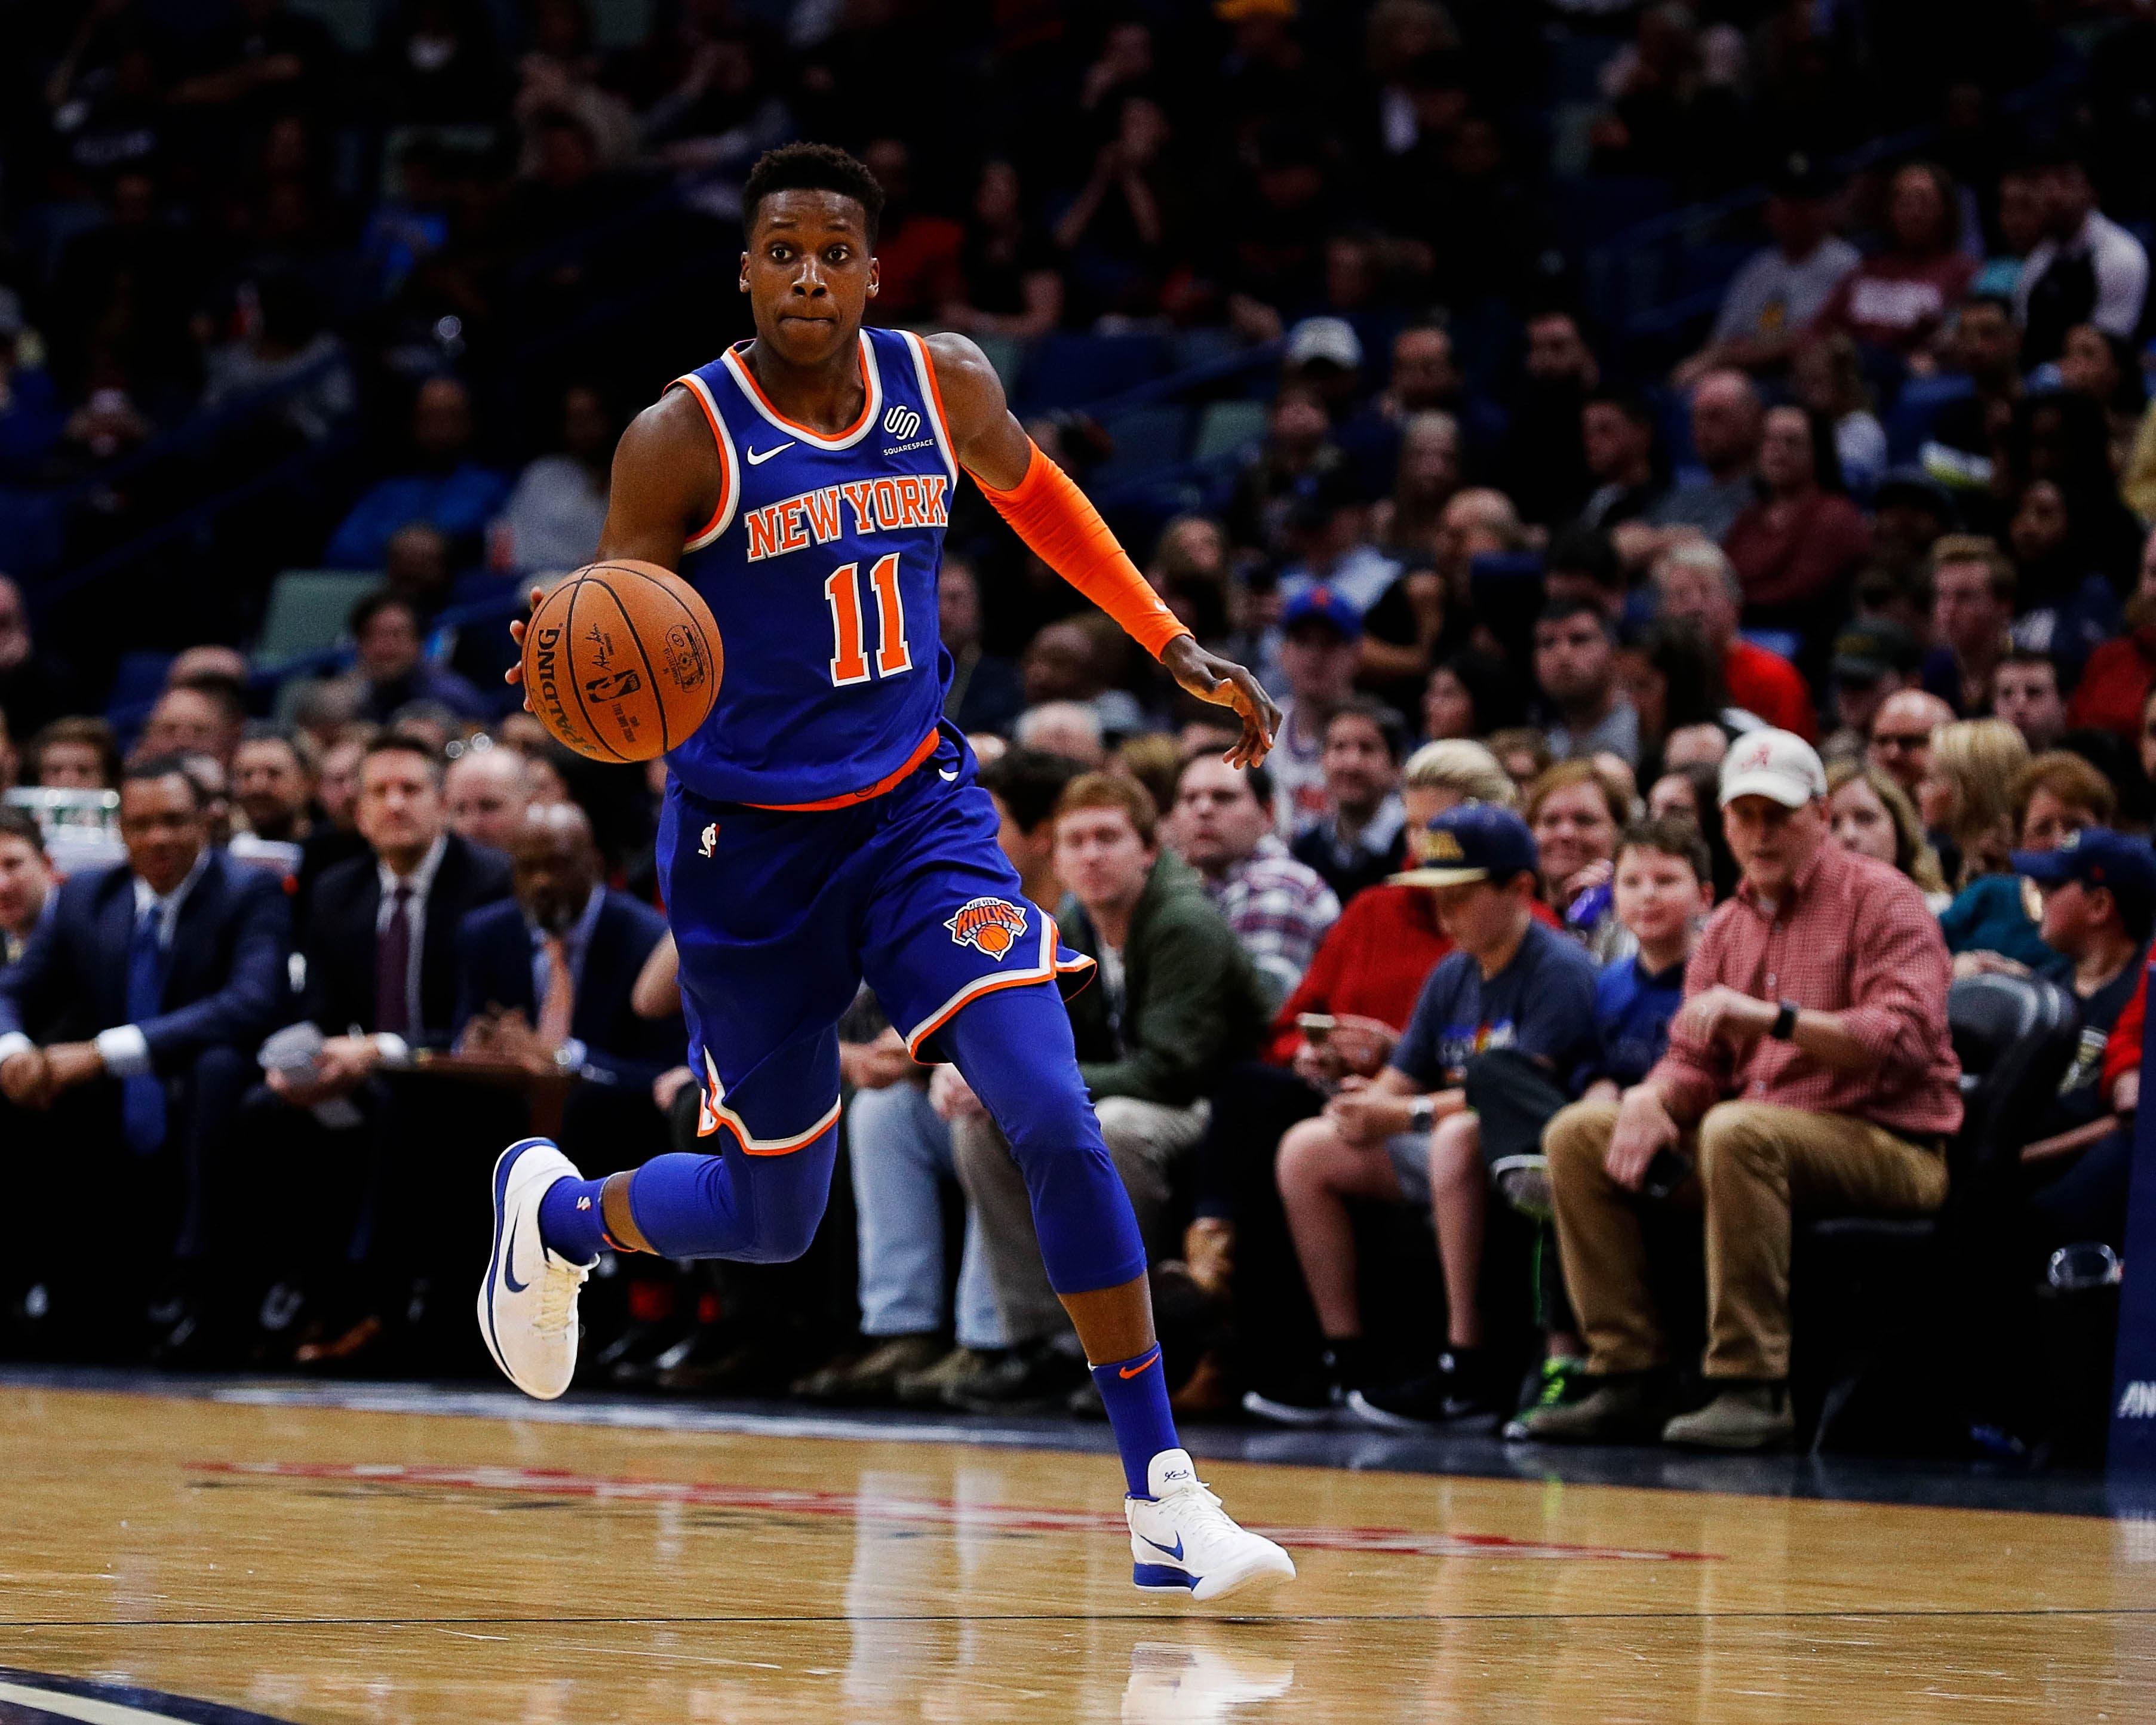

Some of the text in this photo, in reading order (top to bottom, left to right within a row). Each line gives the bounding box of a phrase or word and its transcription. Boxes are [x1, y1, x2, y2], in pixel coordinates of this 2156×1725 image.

[883, 439, 933, 456] SQUARESPACE
[744, 475, 949, 562] NEW YORK
[825, 552, 912, 687] 11
[956, 903, 1025, 940] KNICKS
